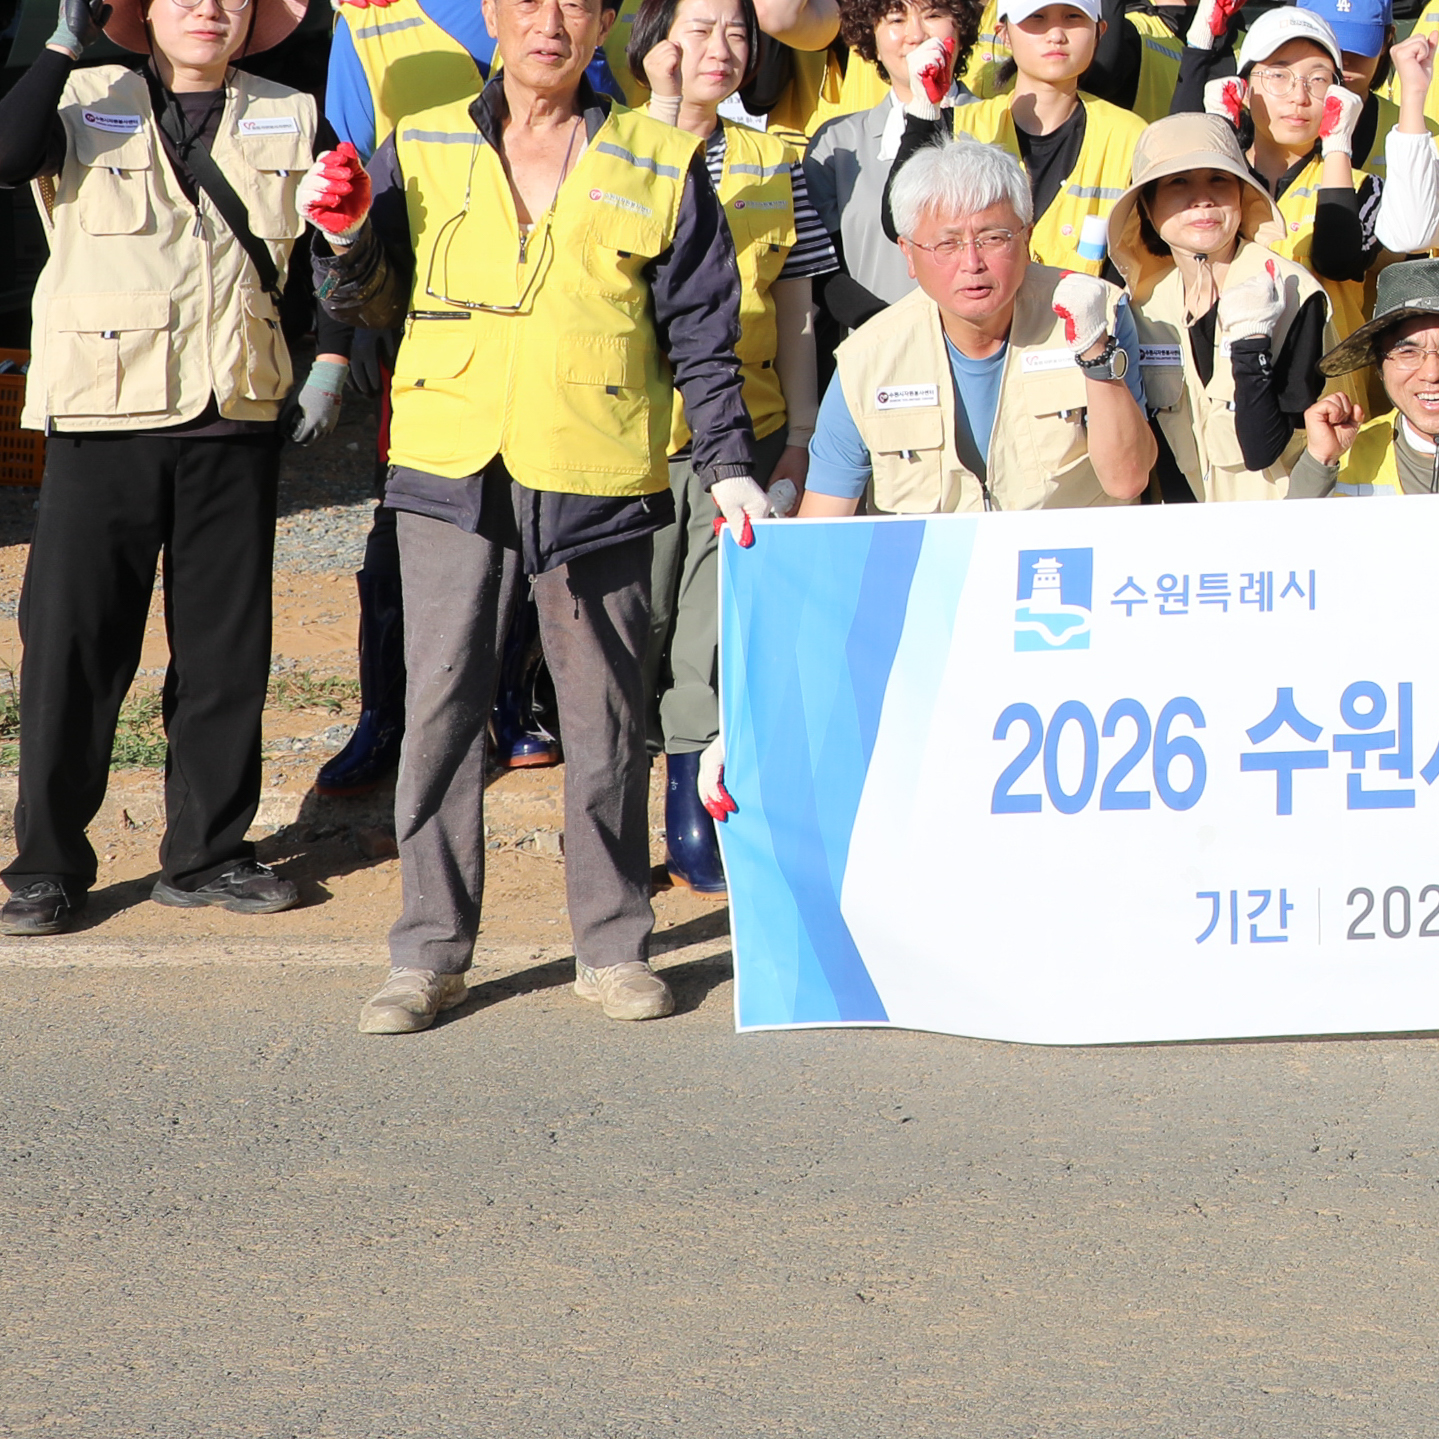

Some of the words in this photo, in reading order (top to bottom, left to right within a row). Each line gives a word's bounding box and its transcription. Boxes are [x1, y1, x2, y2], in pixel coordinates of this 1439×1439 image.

[1110, 569, 1316, 617] 수원특례시
[990, 695, 1208, 815] 2026
[1195, 887, 1295, 945] 기간
